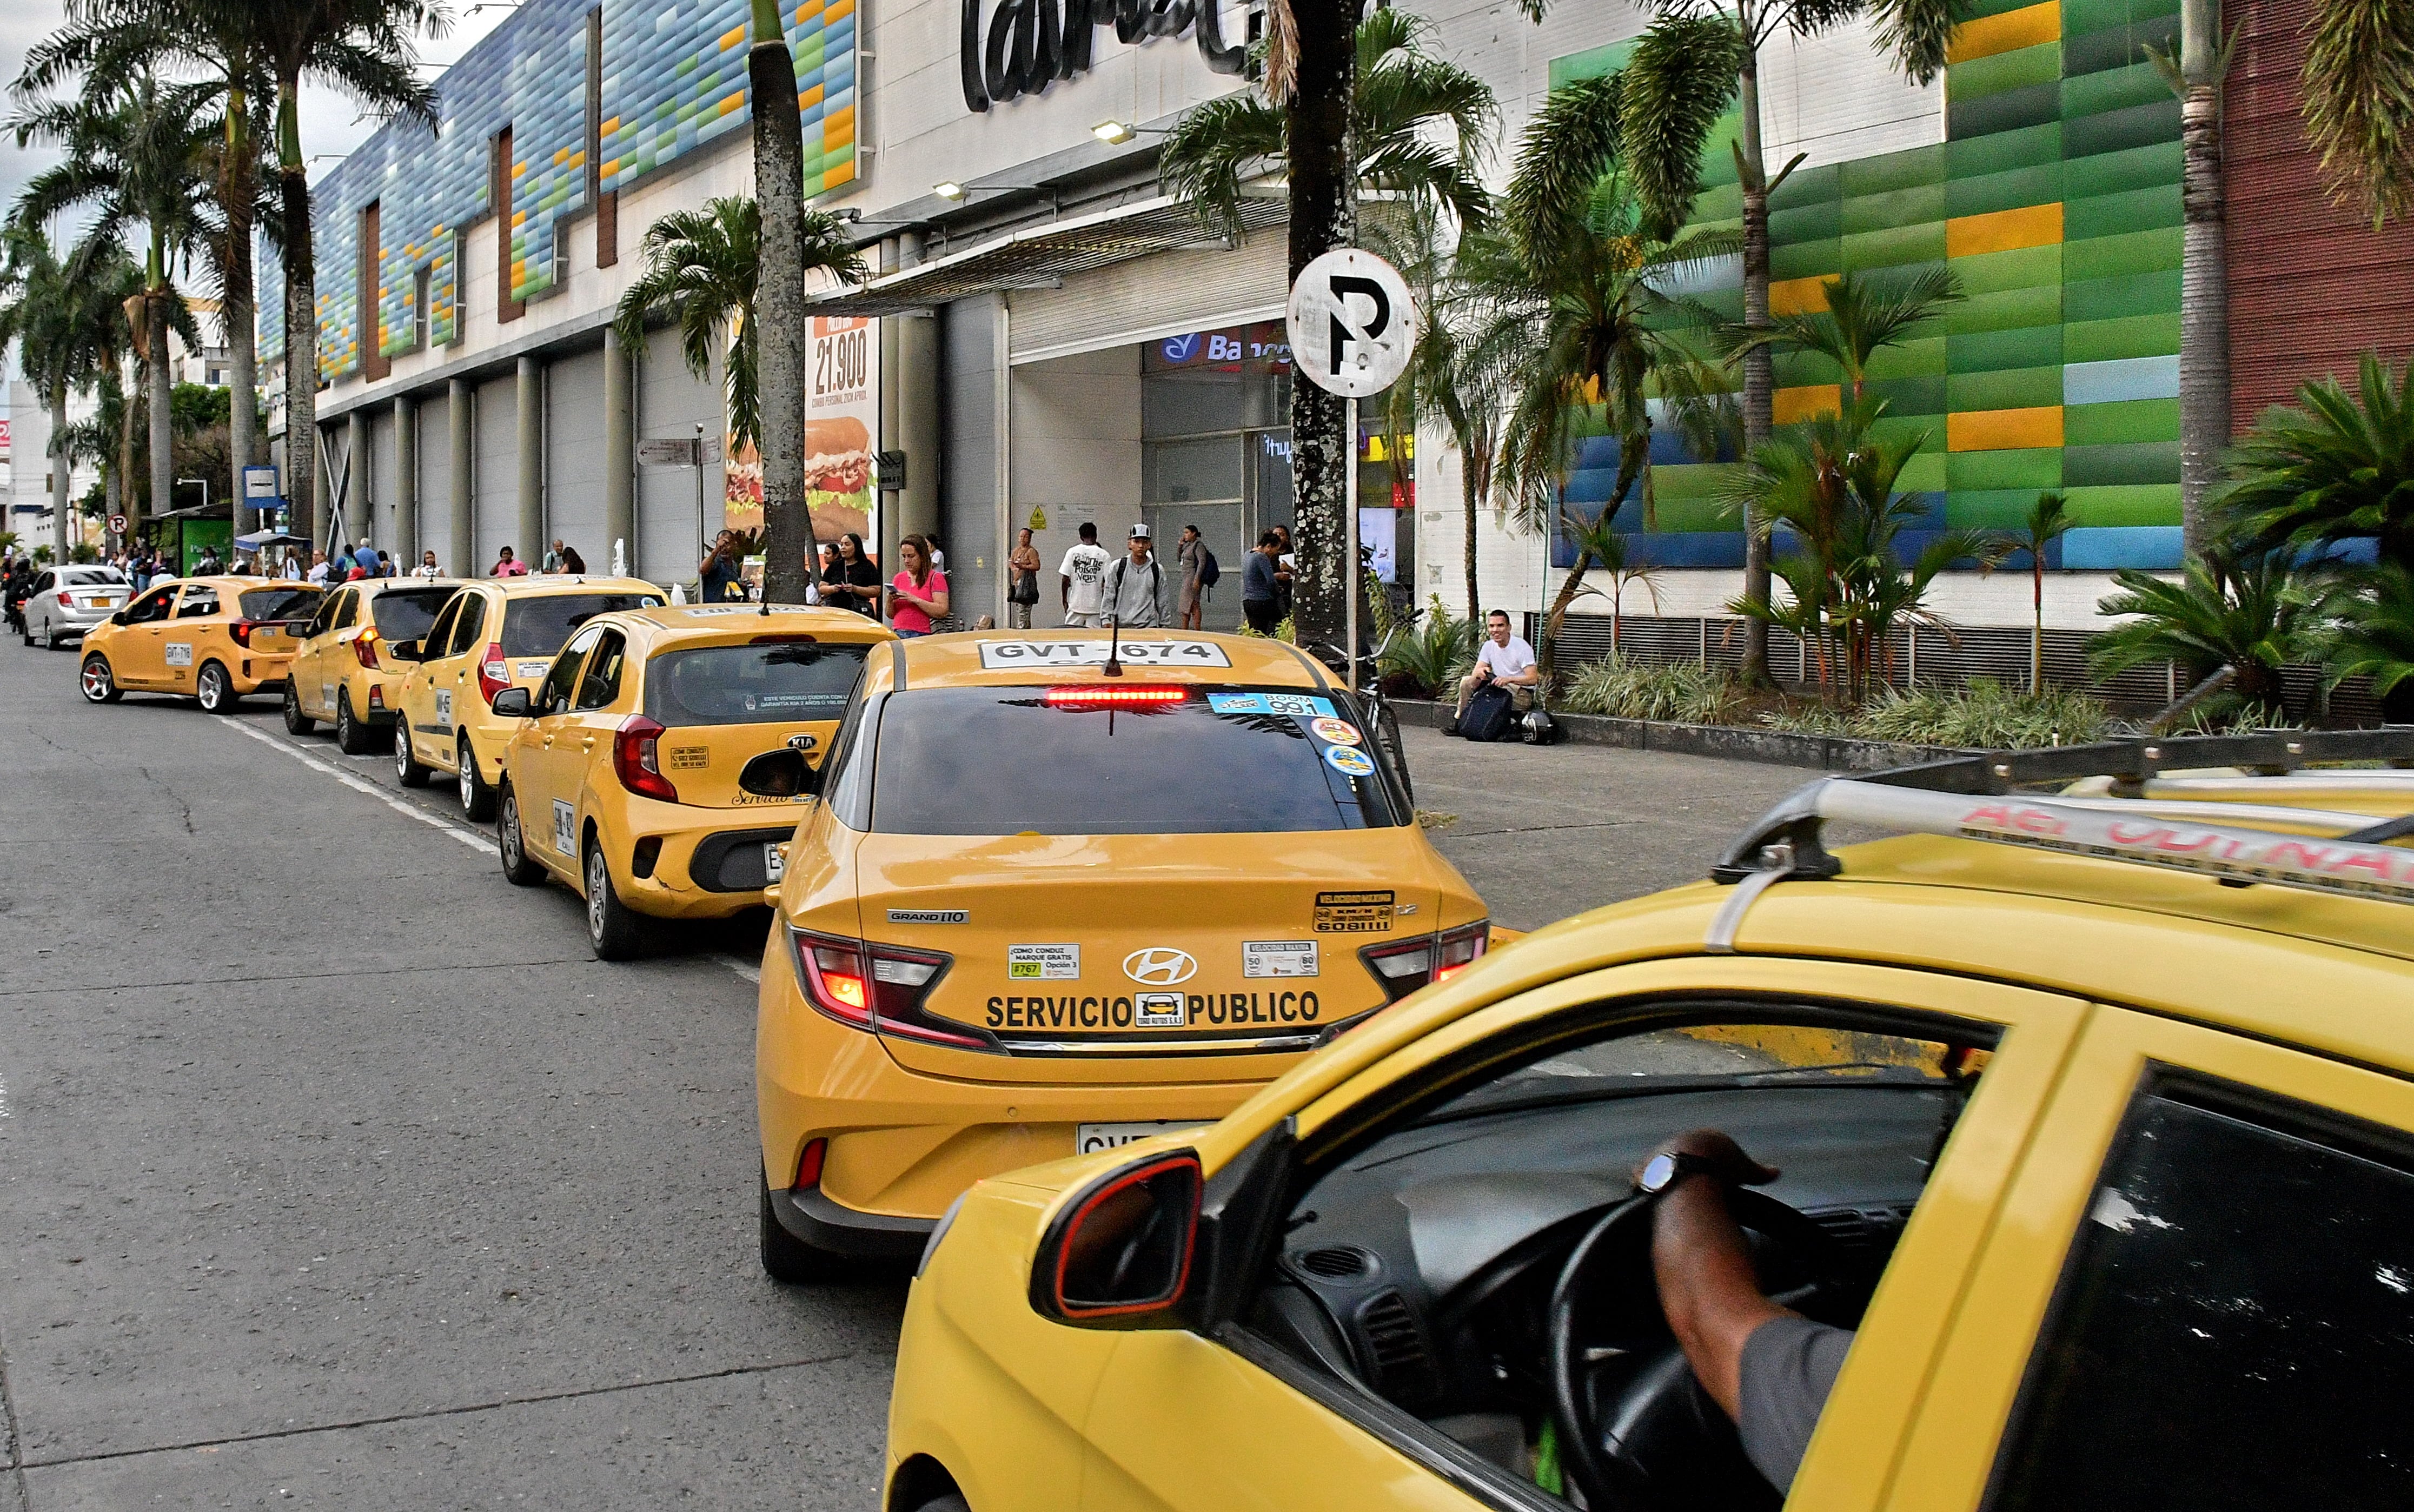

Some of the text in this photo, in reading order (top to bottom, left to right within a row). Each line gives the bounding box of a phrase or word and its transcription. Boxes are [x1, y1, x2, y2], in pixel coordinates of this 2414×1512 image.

[816, 329, 866, 394] 21.900
[995, 644, 1085, 658] GVT
[1120, 645, 1211, 658] 674
[1270, 701, 1318, 715] 99.1
[792, 738, 814, 747] KIA
[891, 912, 964, 922] GRAND i10
[1014, 965, 1037, 973] #767
[1046, 961, 1071, 969] Opción
[986, 991, 1319, 1027] SERVICIO PUBLICO
